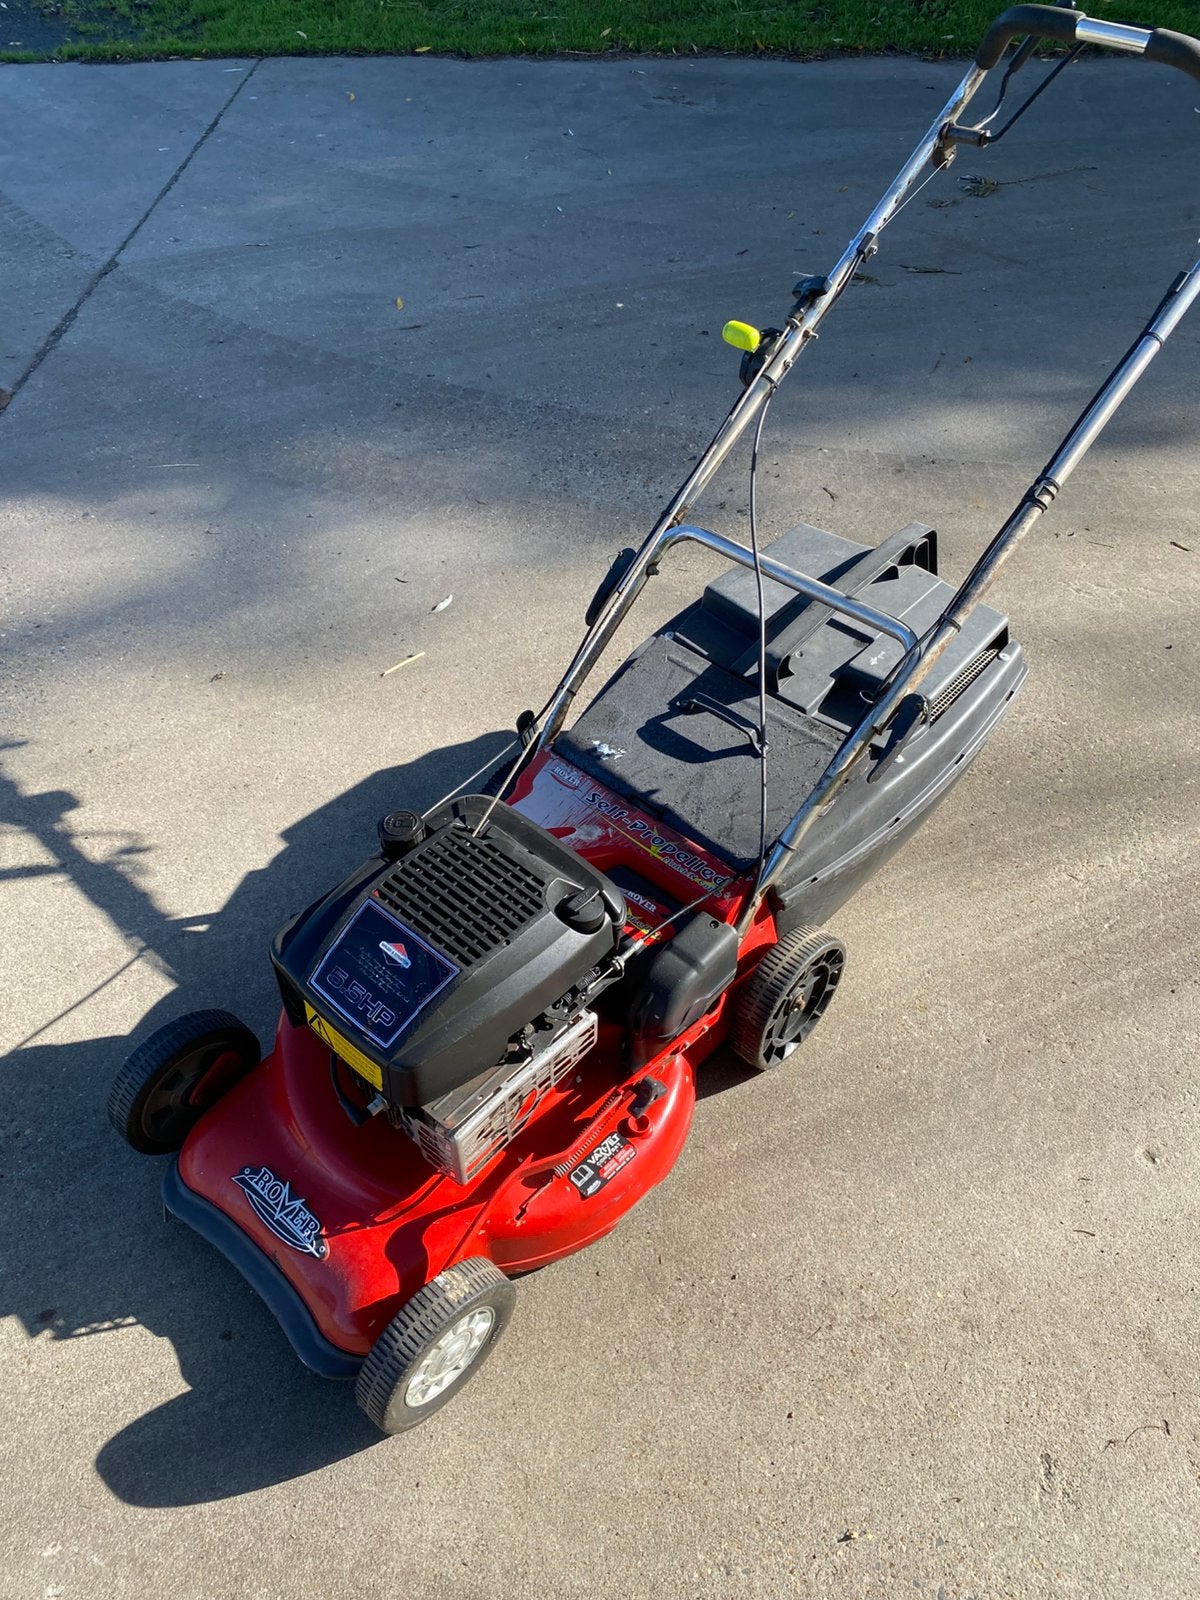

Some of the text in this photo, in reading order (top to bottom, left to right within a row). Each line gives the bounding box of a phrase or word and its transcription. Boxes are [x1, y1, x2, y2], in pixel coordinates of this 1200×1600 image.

[553, 764, 581, 787] ROVER
[585, 791, 731, 886] Self-Propelled
[627, 889, 656, 913] ROVER
[252, 1167, 321, 1243] ROVER
